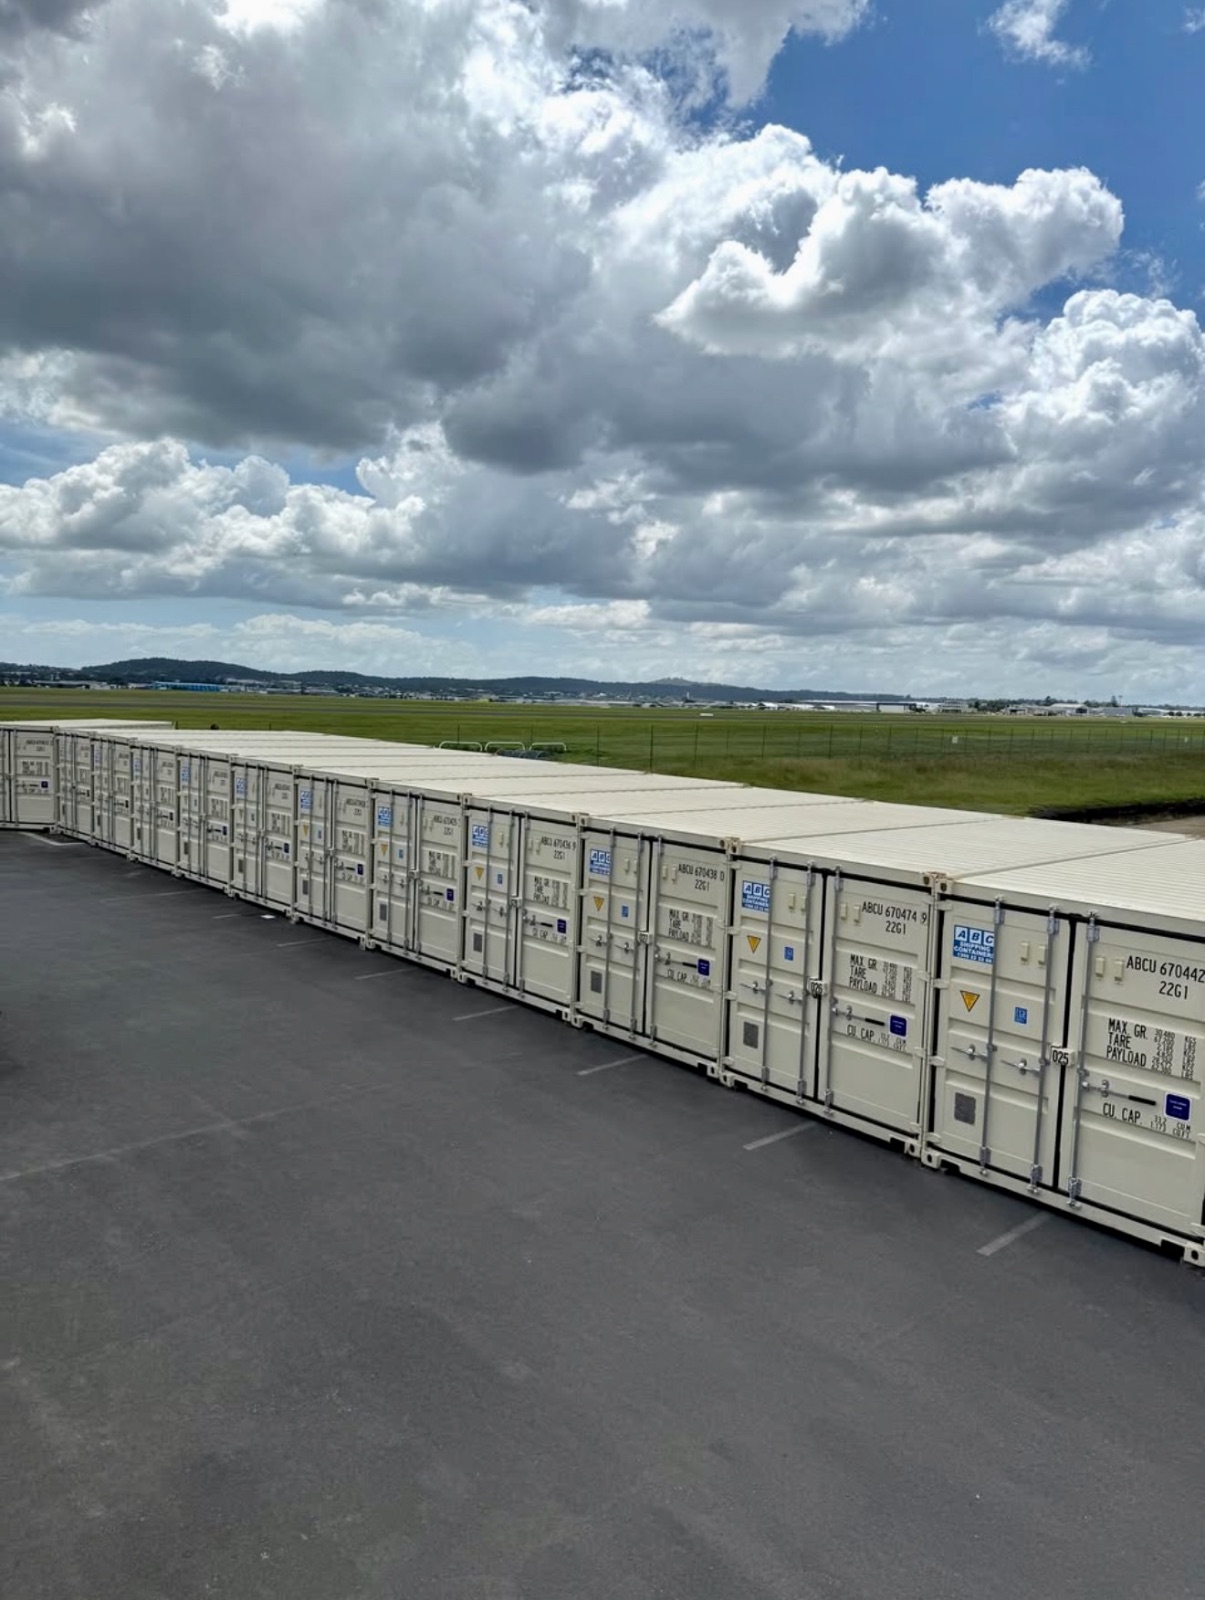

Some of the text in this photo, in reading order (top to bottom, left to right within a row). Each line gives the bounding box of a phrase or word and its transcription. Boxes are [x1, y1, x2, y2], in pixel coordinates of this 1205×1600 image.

[861, 901, 928, 924] ABCU 670474 9
[885, 920, 906, 935] 22G1
[956, 929, 995, 945] ABC
[959, 941, 991, 953] SHIPPING
[849, 965, 867, 980] TARE
[1126, 955, 1205, 984] ABCU 670442
[849, 977, 878, 994] PAYLOAD
[1158, 980, 1188, 1000] 22G1
[1108, 1032, 1132, 1050] TARE
[1052, 1050, 1069, 1066] 025
[1106, 1045, 1147, 1068] PAYLOAD
